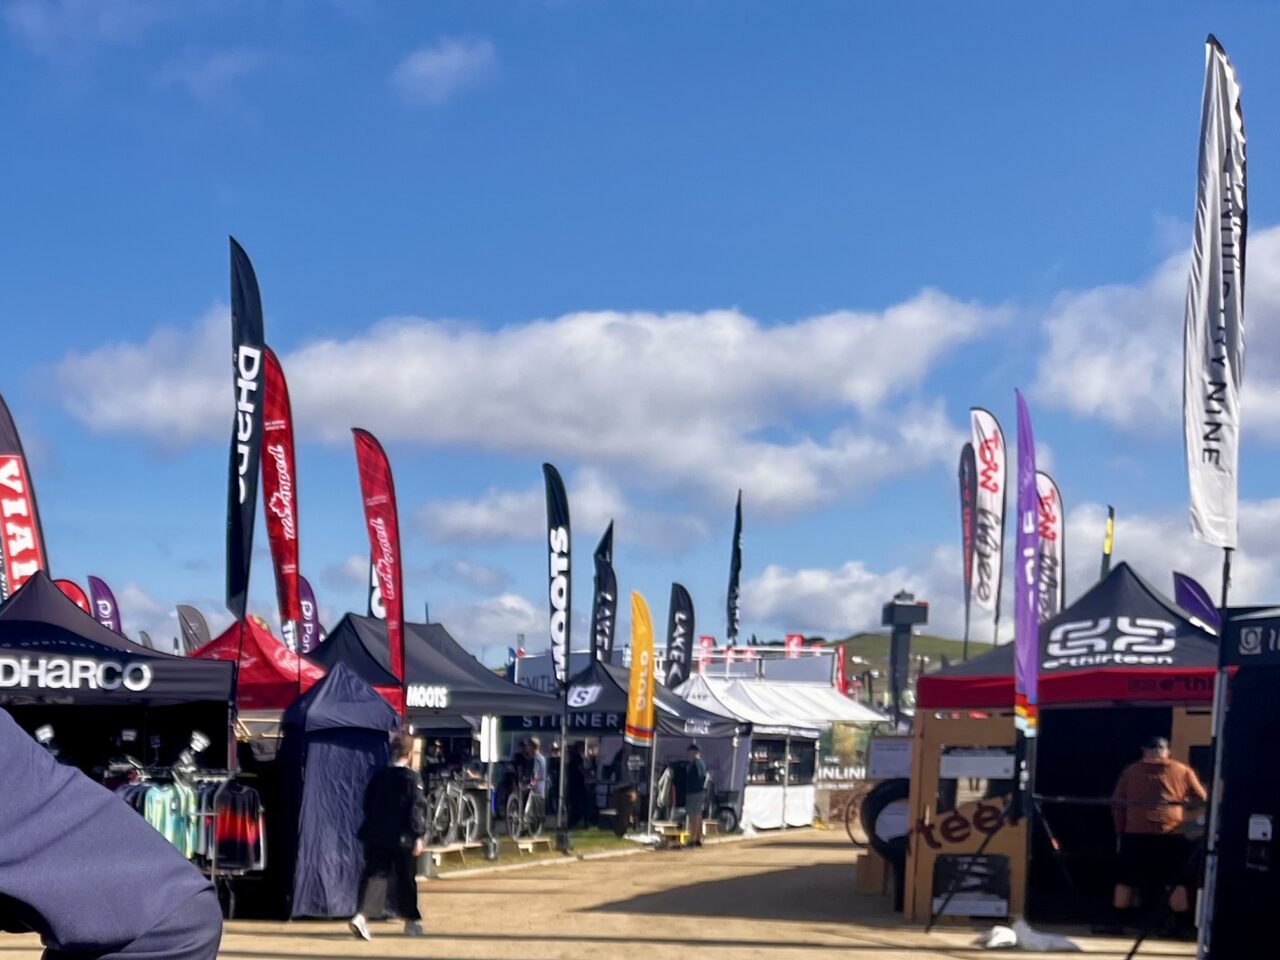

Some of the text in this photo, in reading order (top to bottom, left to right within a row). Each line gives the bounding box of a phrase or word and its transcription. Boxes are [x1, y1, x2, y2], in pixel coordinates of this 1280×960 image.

[1202, 380, 1227, 465] NINE
[670, 611, 687, 664] LAKE
[407, 685, 447, 708] MOOTS
